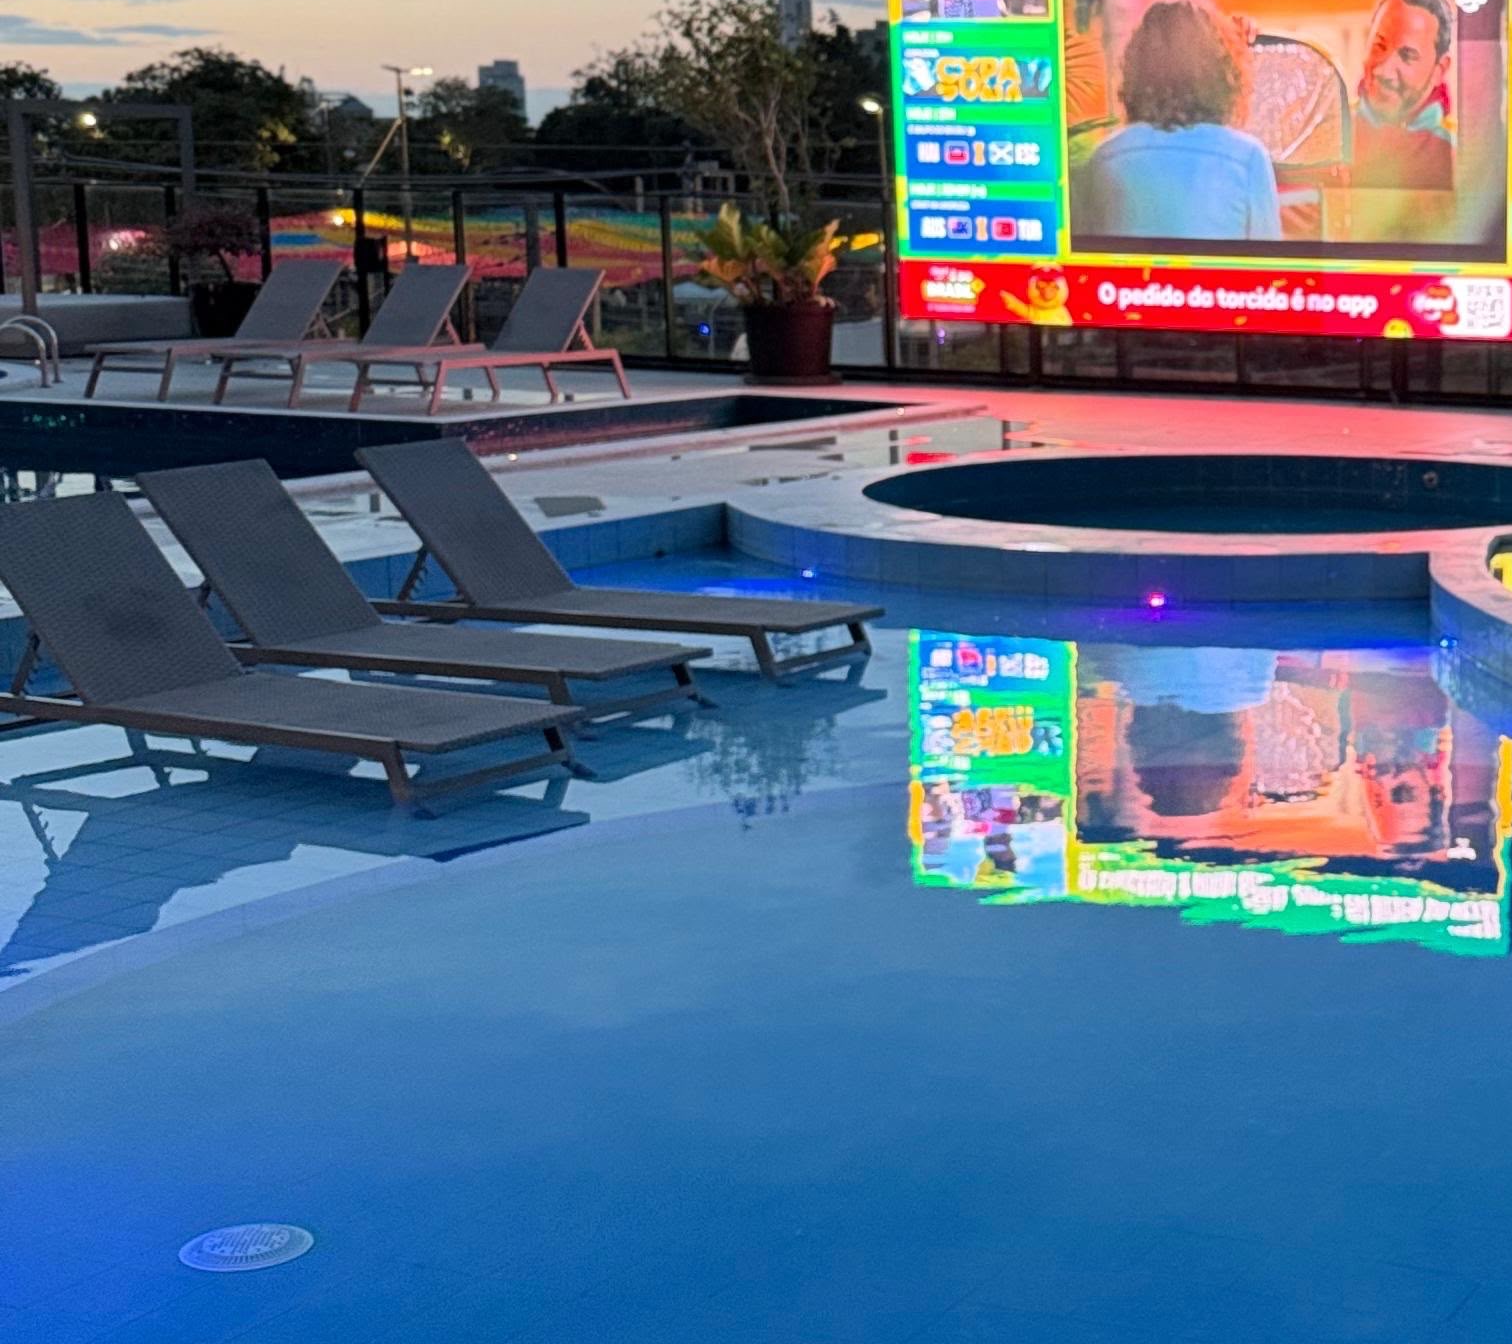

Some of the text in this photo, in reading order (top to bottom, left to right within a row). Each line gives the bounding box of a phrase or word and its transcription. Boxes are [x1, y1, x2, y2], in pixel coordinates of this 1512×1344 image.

[1097, 281, 1379, 319] O pedido da torcida é no app
